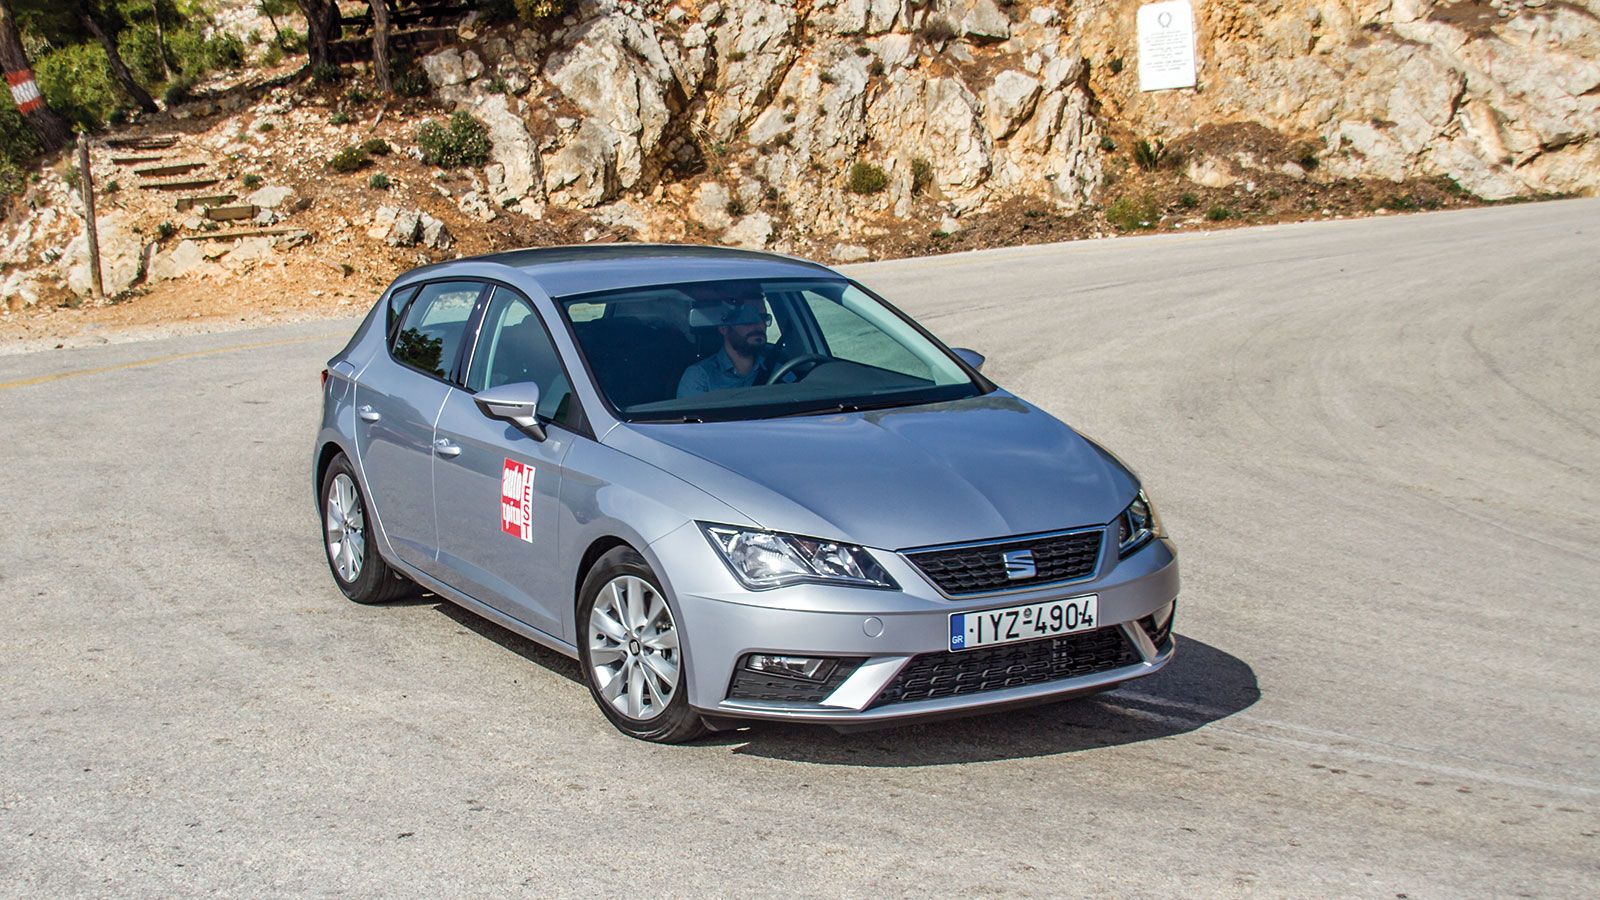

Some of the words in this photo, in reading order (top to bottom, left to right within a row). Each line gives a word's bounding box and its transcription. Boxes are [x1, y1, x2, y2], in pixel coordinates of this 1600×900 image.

[503, 465, 522, 501] auto
[523, 467, 533, 539] TEST
[951, 635, 964, 644] GR
